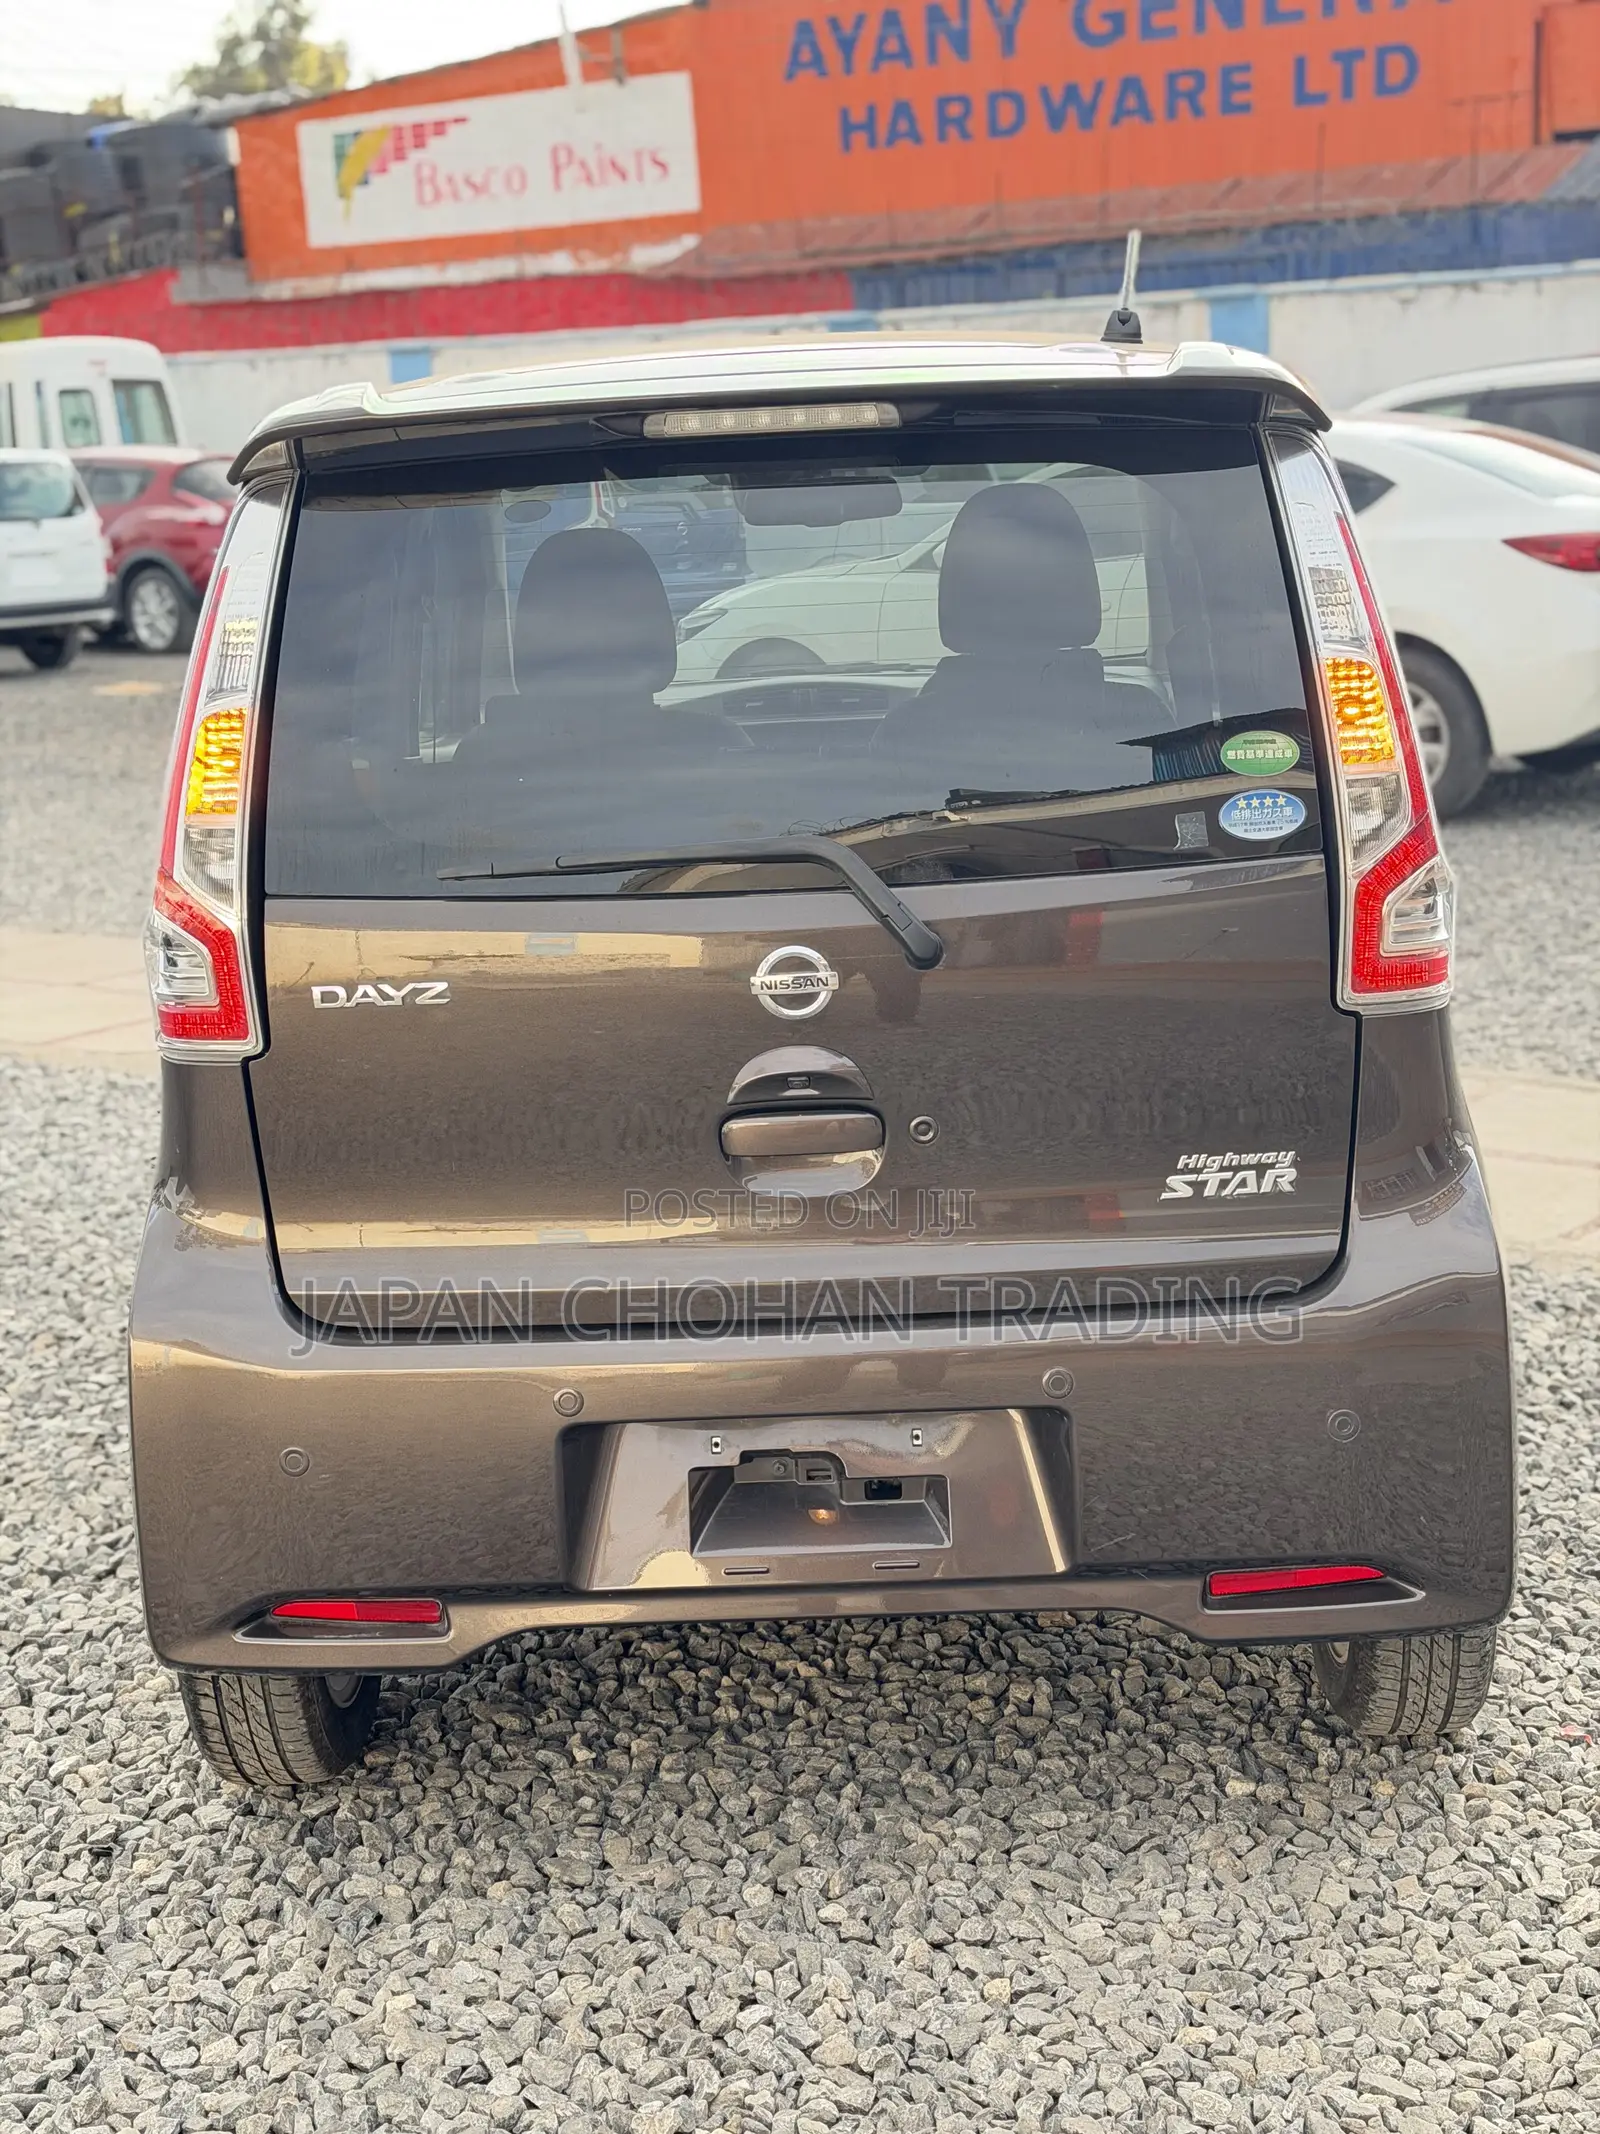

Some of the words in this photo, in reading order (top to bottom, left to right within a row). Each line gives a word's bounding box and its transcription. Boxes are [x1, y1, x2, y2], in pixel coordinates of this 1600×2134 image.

[783, 0, 1027, 82] AYANY
[838, 62, 1253, 154] HARDWARE
[1292, 43, 1419, 108] LTD
[1231, 806, 1294, 821] 低排出ガス車
[311, 981, 451, 1009] DAYZ
[760, 976, 829, 991] NISSAN
[1177, 1150, 1296, 1174] Highway
[1160, 1168, 1298, 1200] STAR
